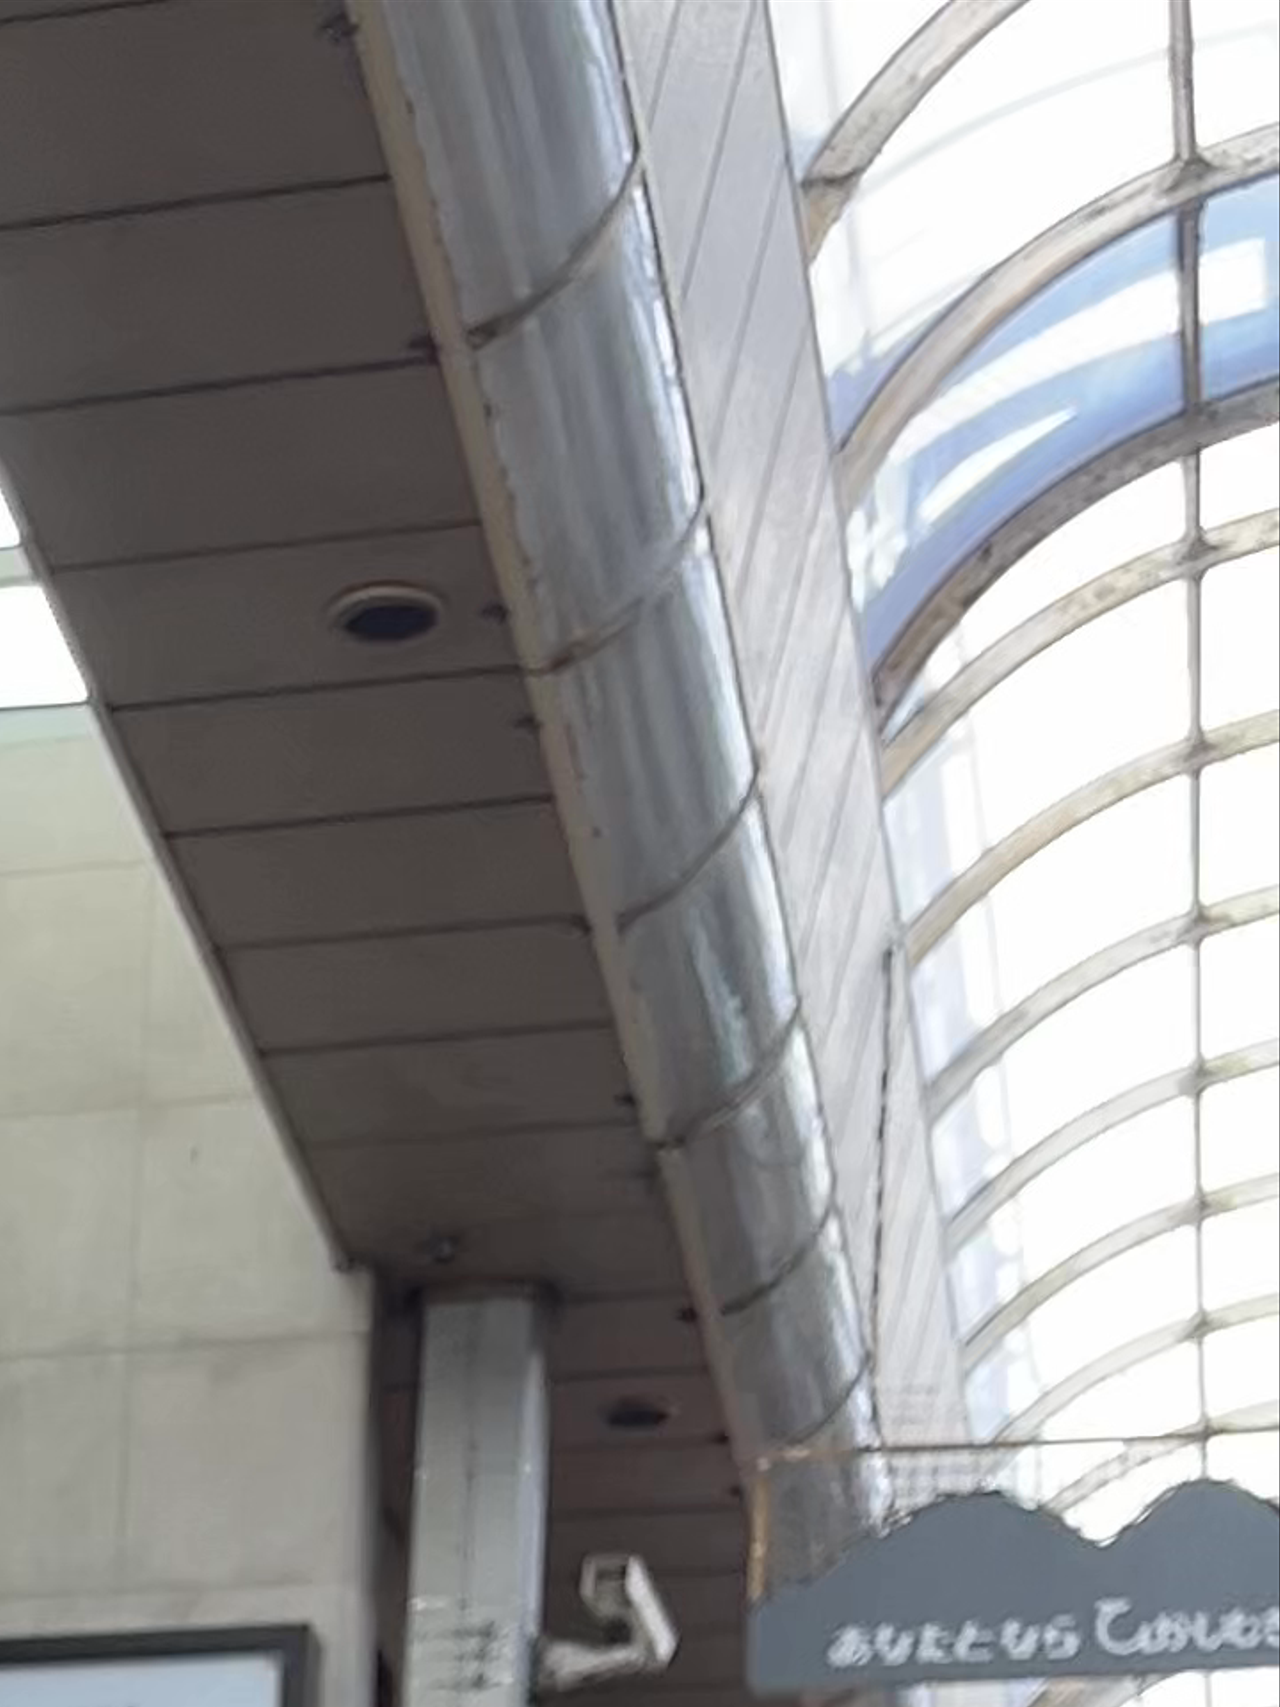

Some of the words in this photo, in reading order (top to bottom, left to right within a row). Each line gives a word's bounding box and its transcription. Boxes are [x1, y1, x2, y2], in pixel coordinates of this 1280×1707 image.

[827, 1612, 1083, 1668] あなたとなら
